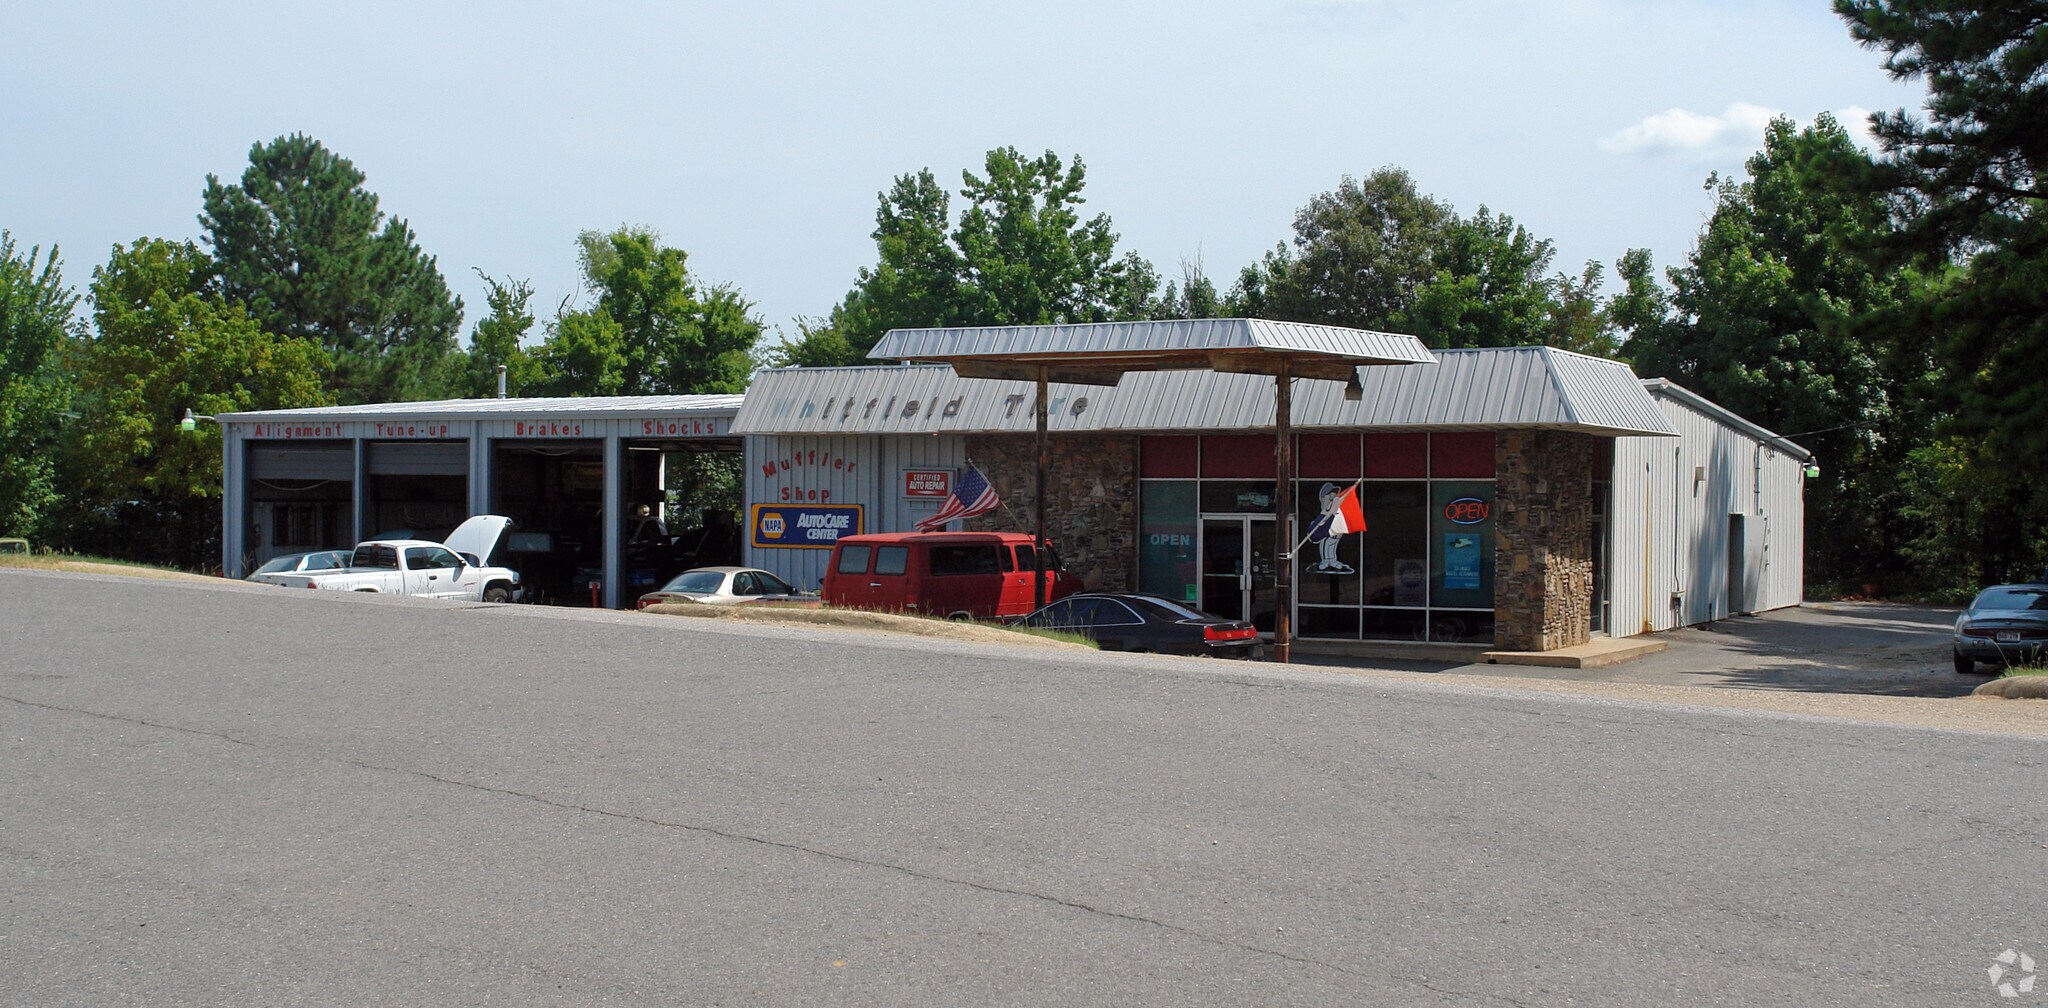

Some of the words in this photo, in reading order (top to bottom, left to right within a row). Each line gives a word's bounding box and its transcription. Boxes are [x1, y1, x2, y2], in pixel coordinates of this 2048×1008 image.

[255, 423, 342, 439] Alignment
[377, 423, 447, 438] Tune-up
[515, 421, 580, 435] Brakes
[644, 419, 714, 434] Shocks
[762, 450, 856, 478] Muffler
[913, 473, 941, 481] CERTIFIED
[909, 481, 924, 490] AUTO
[924, 481, 945, 490] REPAIR
[781, 486, 830, 503] Shop
[1445, 502, 1490, 519] OPEN
[764, 520, 782, 532] NAPA
[806, 528, 839, 540] CENTER
[1150, 534, 1190, 546] OPEN
